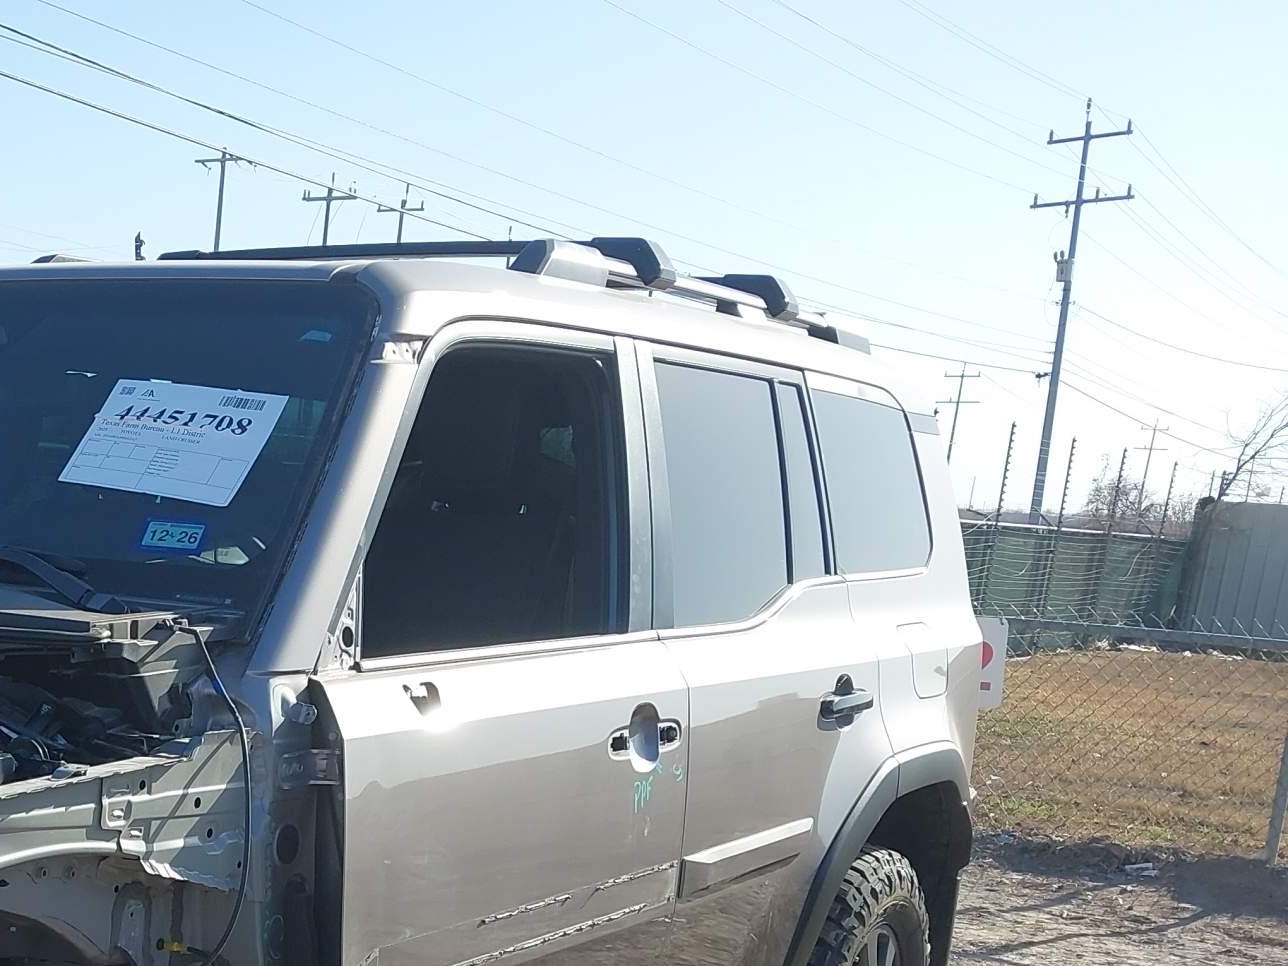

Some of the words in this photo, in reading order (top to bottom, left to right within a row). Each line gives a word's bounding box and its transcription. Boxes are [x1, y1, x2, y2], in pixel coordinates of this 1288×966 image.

[114, 404, 253, 436] 44451708
[150, 529, 169, 541] 12
[177, 531, 199, 544] 26
